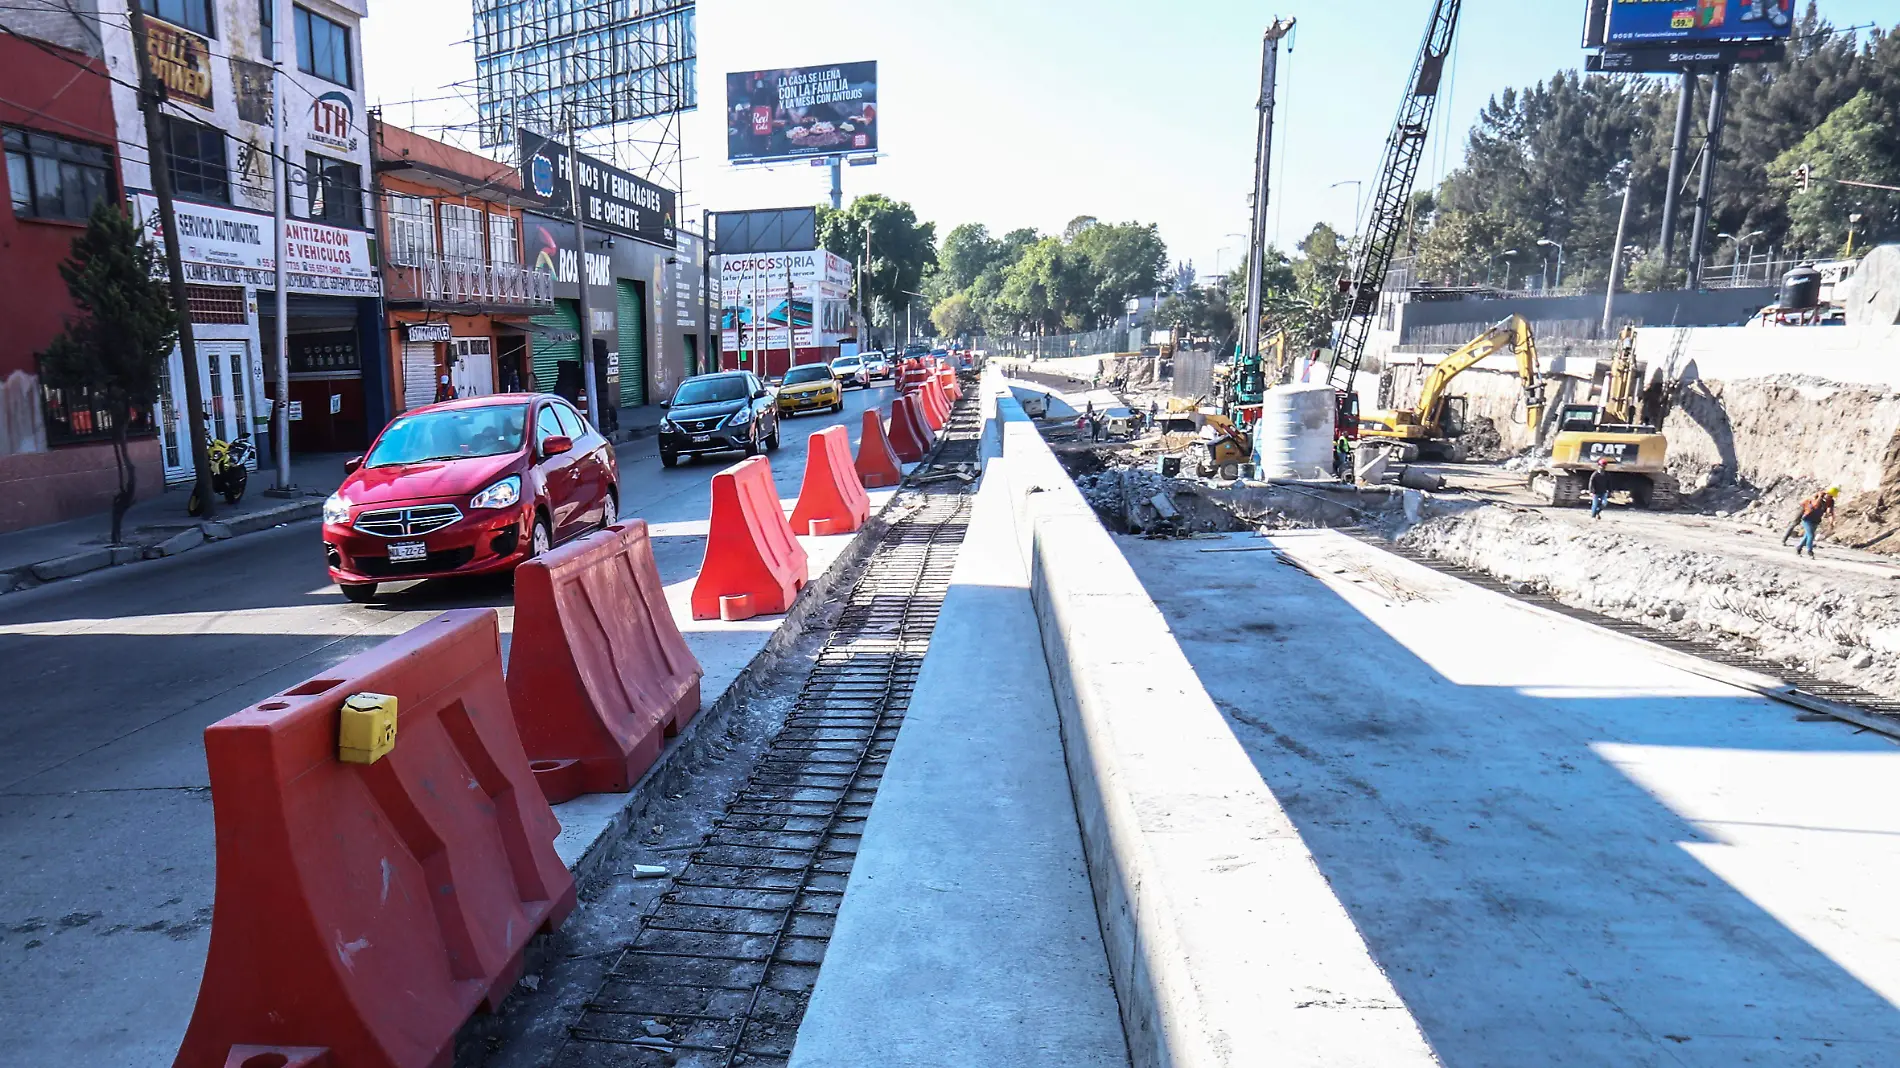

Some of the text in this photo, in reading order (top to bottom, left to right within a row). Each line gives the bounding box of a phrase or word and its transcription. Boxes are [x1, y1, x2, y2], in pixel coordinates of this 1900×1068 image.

[147, 28, 188, 68] FULL
[1695, 52, 1720, 61] Channel
[778, 69, 841, 88] LA CASA SE LLENA
[778, 78, 848, 100] CON LA FAMILIA
[779, 88, 863, 110] Y LA MESA CON ANTOJOS
[313, 100, 347, 138] LTH
[752, 110, 769, 124] Red
[755, 123, 768, 131] Cola
[558, 154, 661, 213] FRNOS Y EMBRAGUES
[589, 196, 640, 231] DE ORIENTE
[179, 213, 261, 245] SERVICIO AUTOMOTRIZ
[286, 224, 349, 247] ANITIZACIÓN
[296, 243, 351, 264] VEHICULOS
[559, 249, 611, 286] ROSFRANS
[1590, 443, 1627, 462] CAT
